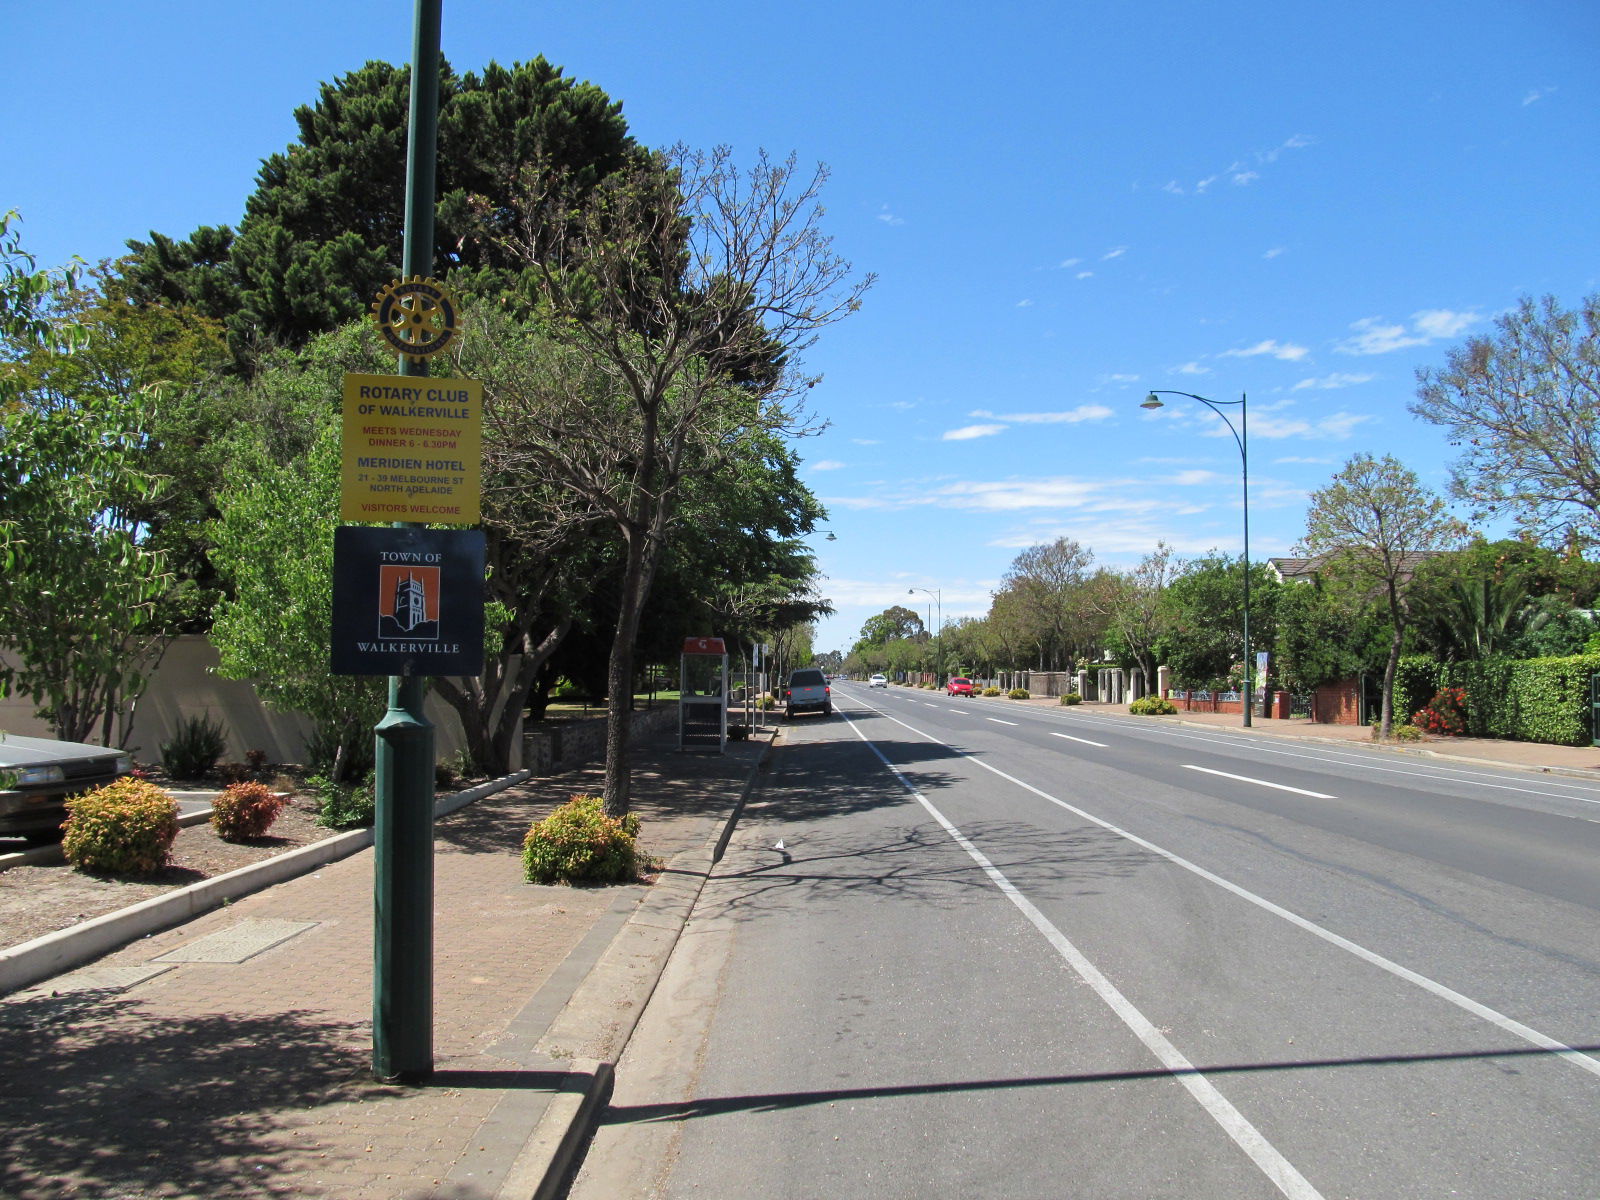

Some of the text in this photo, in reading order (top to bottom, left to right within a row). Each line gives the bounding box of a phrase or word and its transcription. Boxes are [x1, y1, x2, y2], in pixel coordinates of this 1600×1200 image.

[360, 386, 469, 402] ROTARY CLUB
[358, 404, 470, 418] OF WALKERVILLE
[362, 426, 462, 437] MEETS WEDNESDAY
[369, 438, 407, 447] DINNER
[423, 440, 457, 449] 6.30PM
[358, 457, 466, 471] MERIDIEN HOTEL
[358, 474, 368, 482] 21
[377, 474, 388, 482] 39
[390, 475, 449, 484] MELBOURNE
[453, 477, 464, 485] ST
[370, 485, 453, 495] NORTH ADELAIDE
[361, 503, 461, 514] VISITORS WELCOME
[380, 551, 442, 562] TOWN OF
[357, 642, 460, 654] WALKERVILLE
